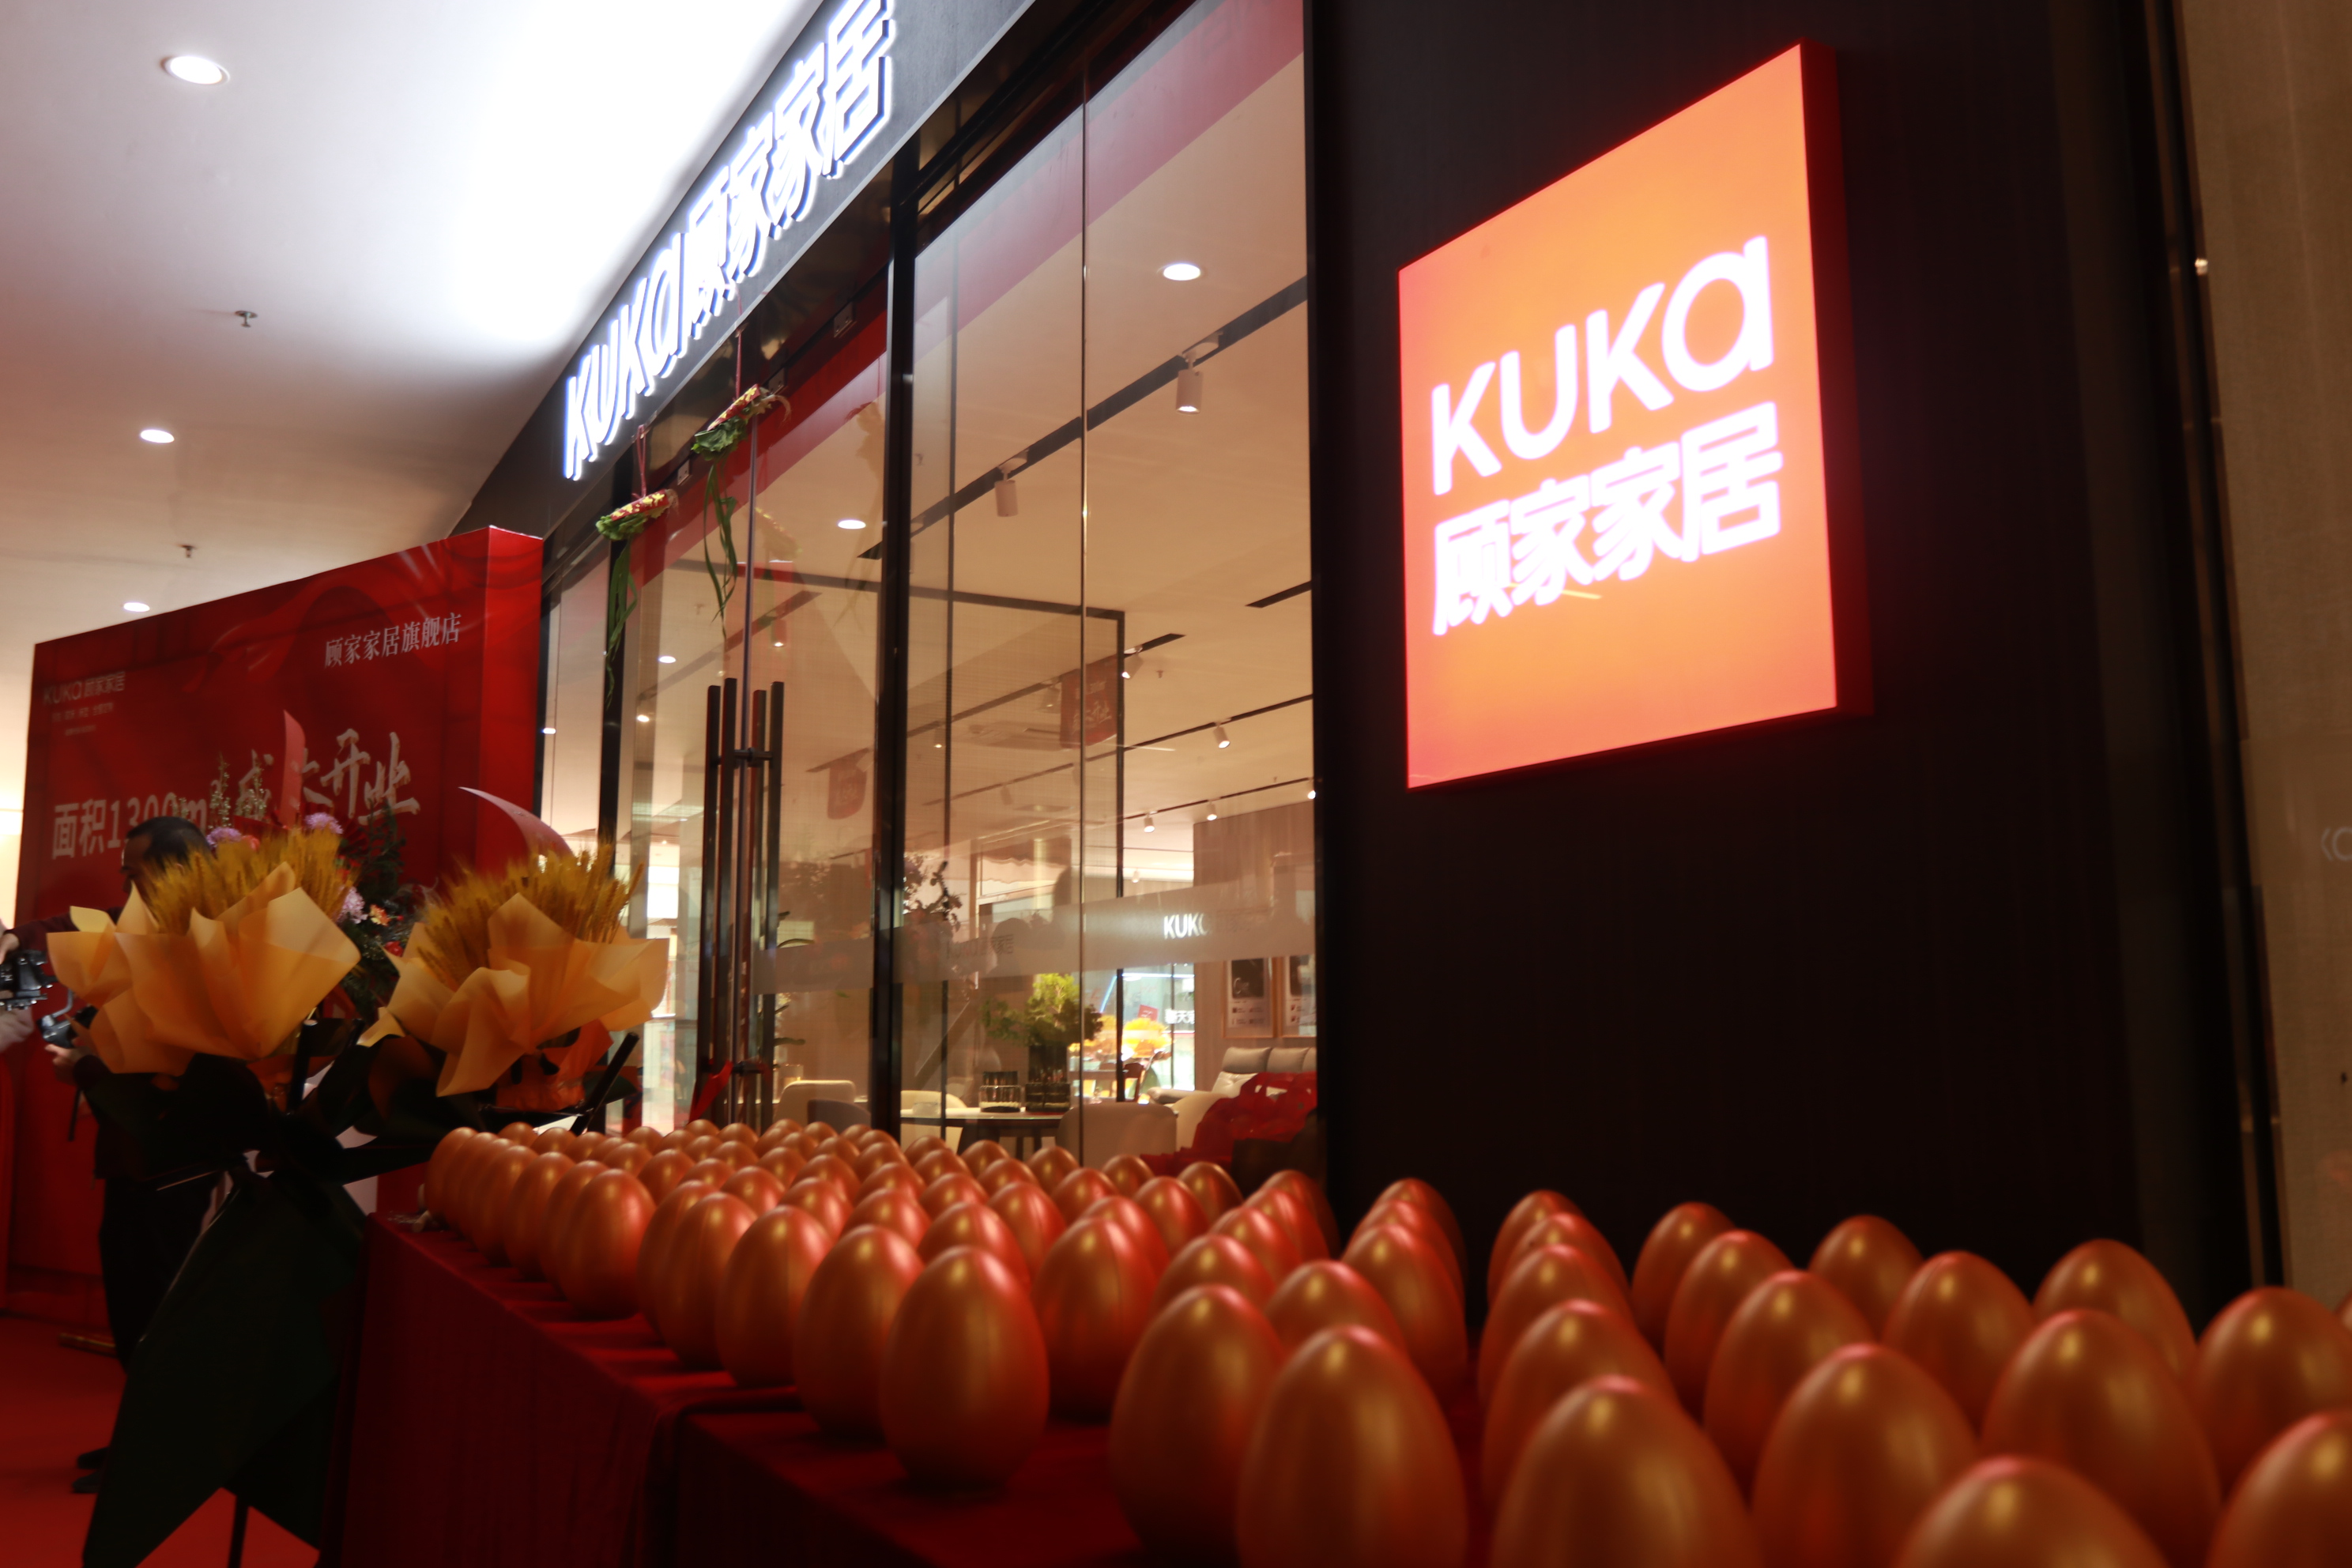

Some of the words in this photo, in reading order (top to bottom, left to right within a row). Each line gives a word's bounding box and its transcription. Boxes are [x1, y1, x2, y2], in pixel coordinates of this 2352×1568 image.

[683, 0, 893, 339] 顾家家居
[1432, 401, 1783, 635] 顾家家居
[324, 612, 462, 669] 顾家家居旗舰店
